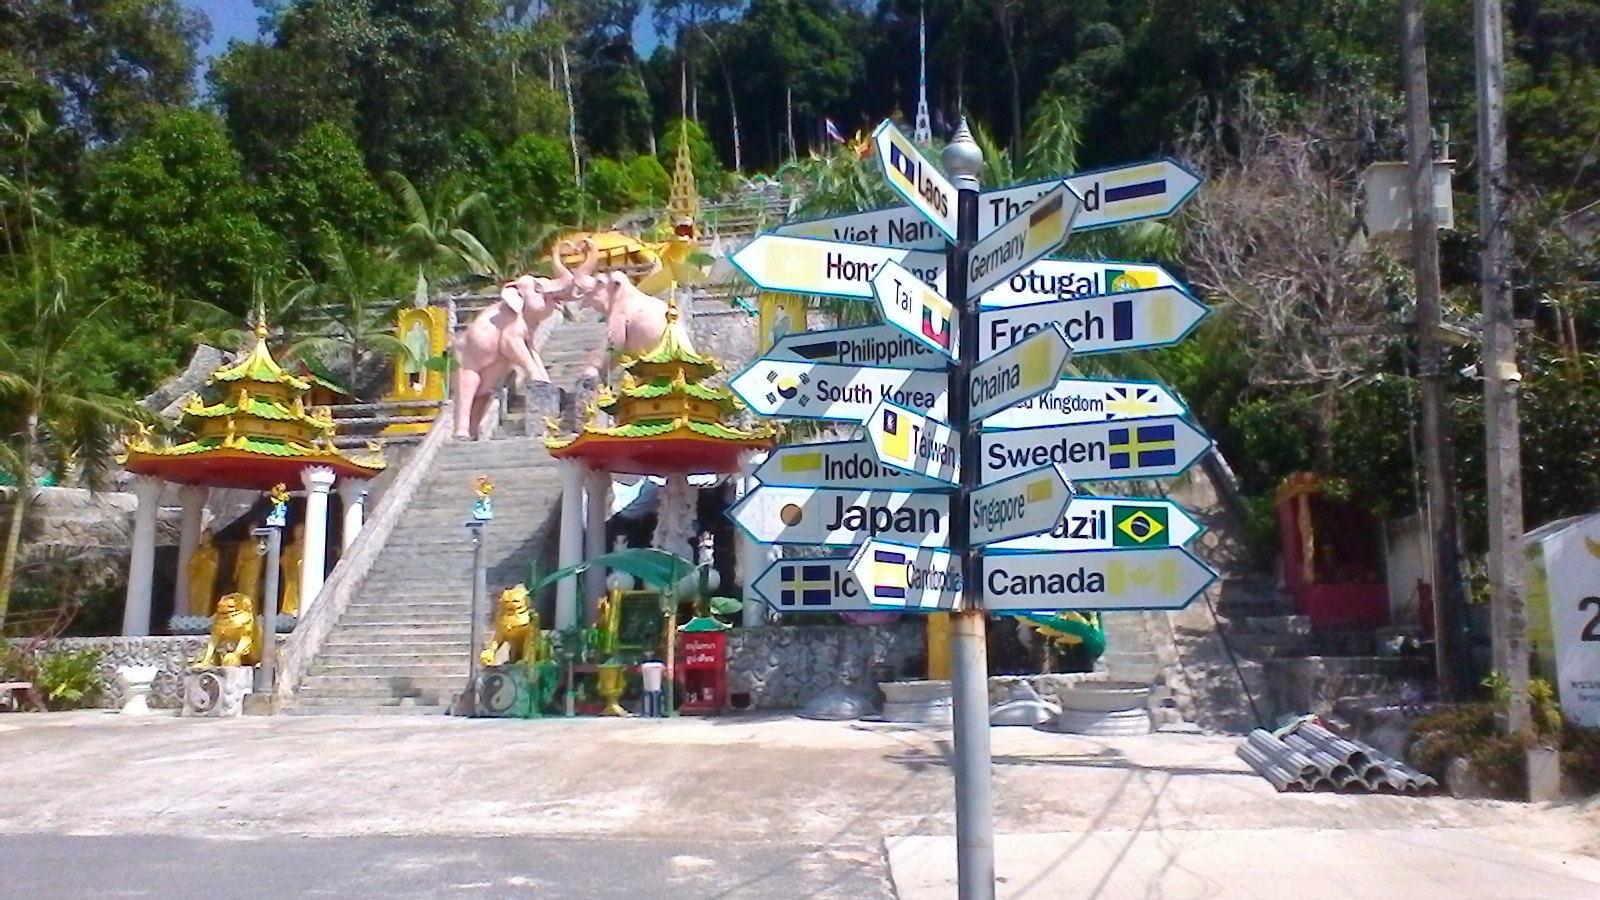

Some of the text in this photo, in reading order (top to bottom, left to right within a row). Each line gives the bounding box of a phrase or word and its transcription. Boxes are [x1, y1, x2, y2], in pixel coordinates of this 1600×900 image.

[919, 161, 948, 218] Laos
[970, 228, 1027, 283] Germany
[894, 279, 912, 315] Tai
[991, 310, 1104, 350] Frech
[817, 380, 935, 408] South Korea
[971, 363, 1020, 407] Chaina
[1040, 392, 1104, 414] Kingdom
[912, 424, 956, 469] Taiwan
[988, 438, 1105, 470] Sweden
[827, 496, 940, 537] Japan
[973, 493, 1025, 532] Singapore
[1037, 509, 1106, 540] azil
[907, 560, 964, 592] Cambodia
[988, 567, 1105, 595] Canada
